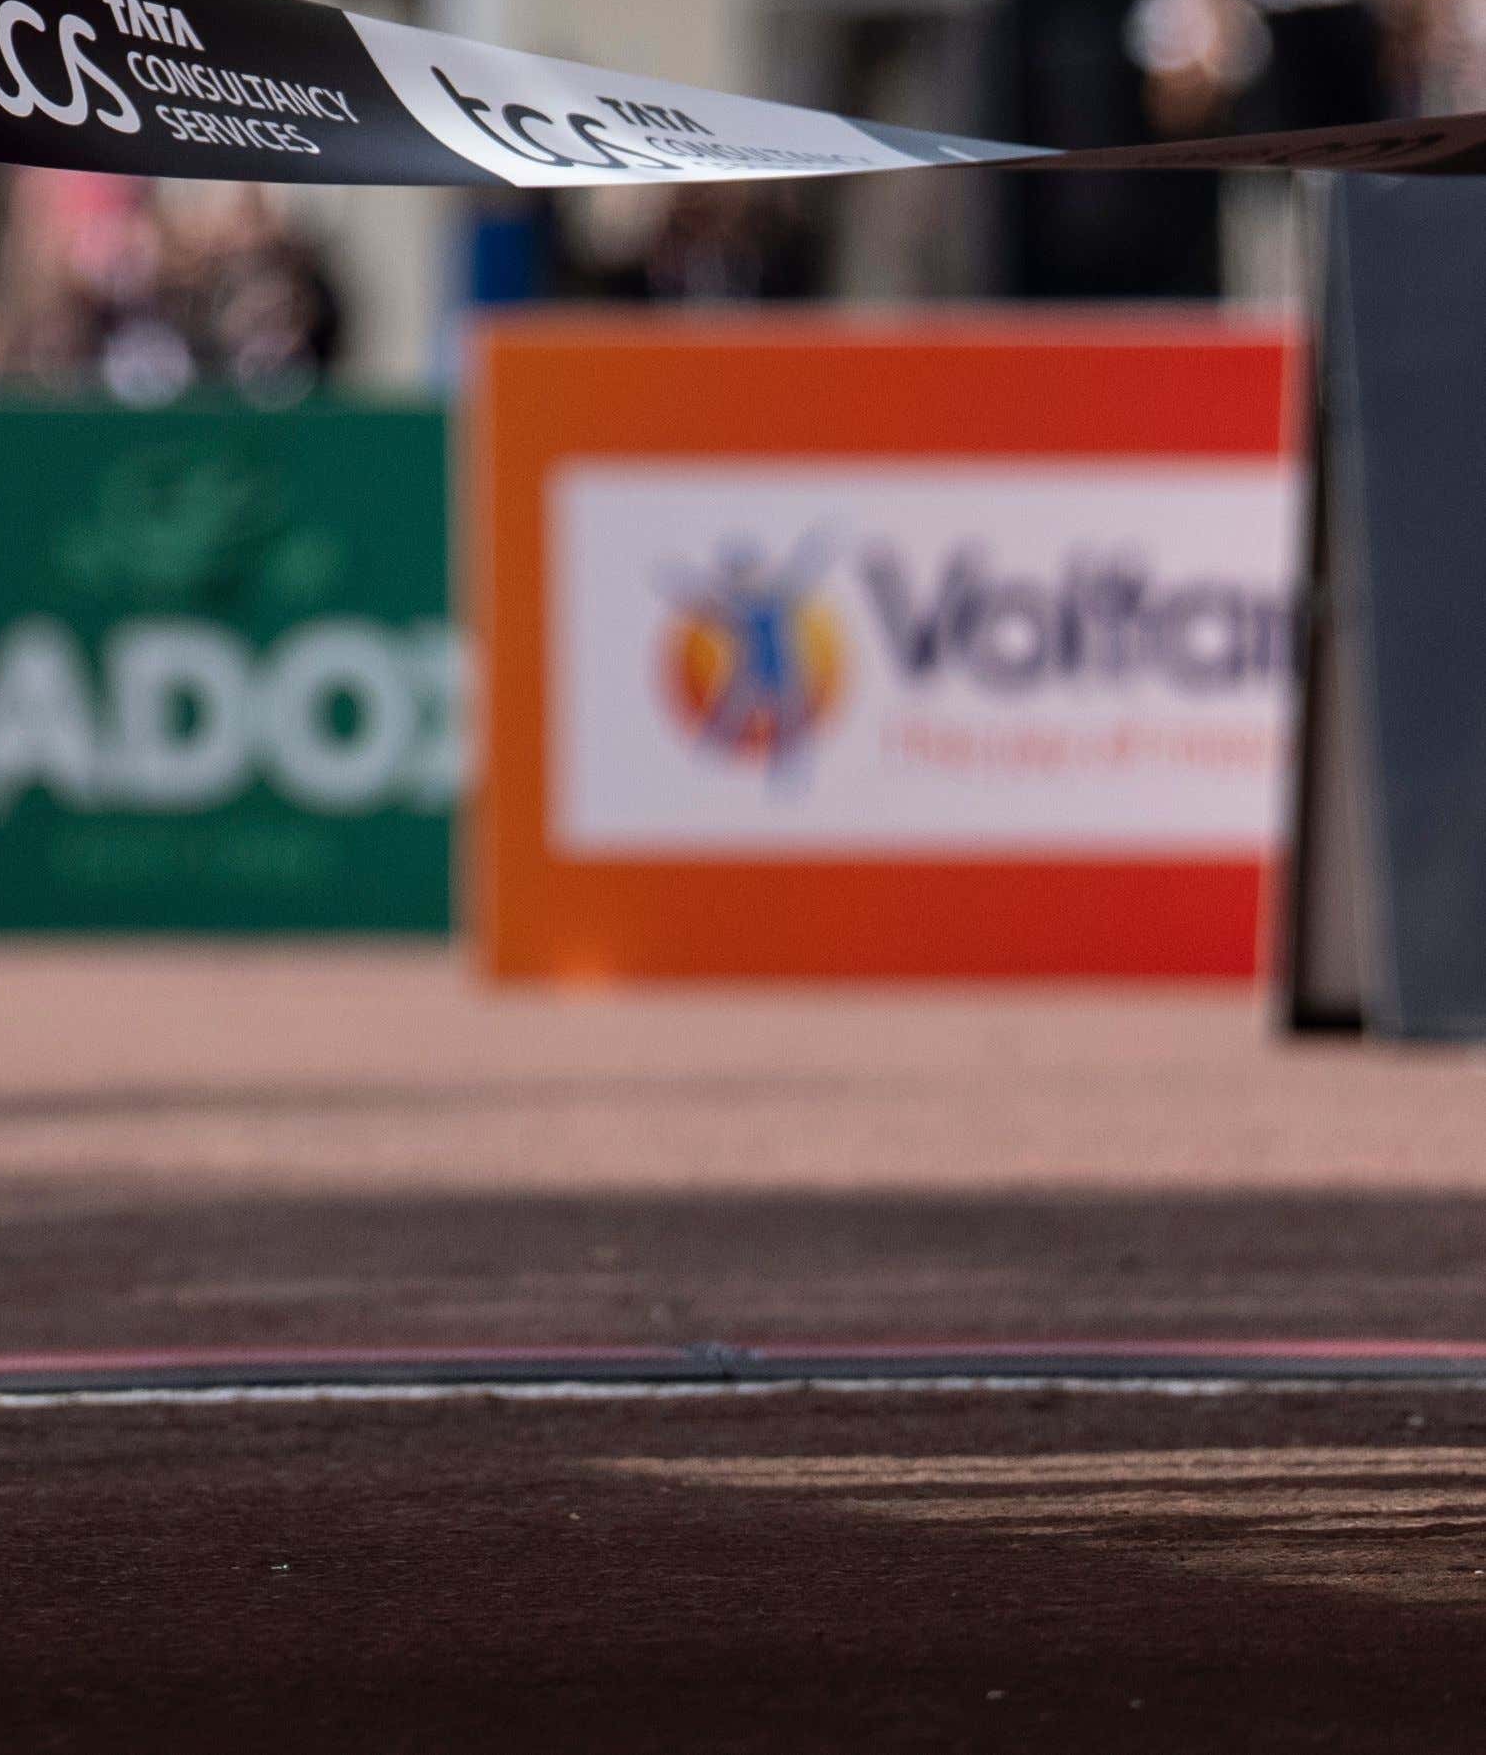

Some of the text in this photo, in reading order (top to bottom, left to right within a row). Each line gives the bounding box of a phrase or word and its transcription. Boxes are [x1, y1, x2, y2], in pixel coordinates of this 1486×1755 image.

[127, 51, 360, 124] CONSULTANCY
[155, 104, 321, 156] SERVICES
[596, 95, 715, 136] TATA
